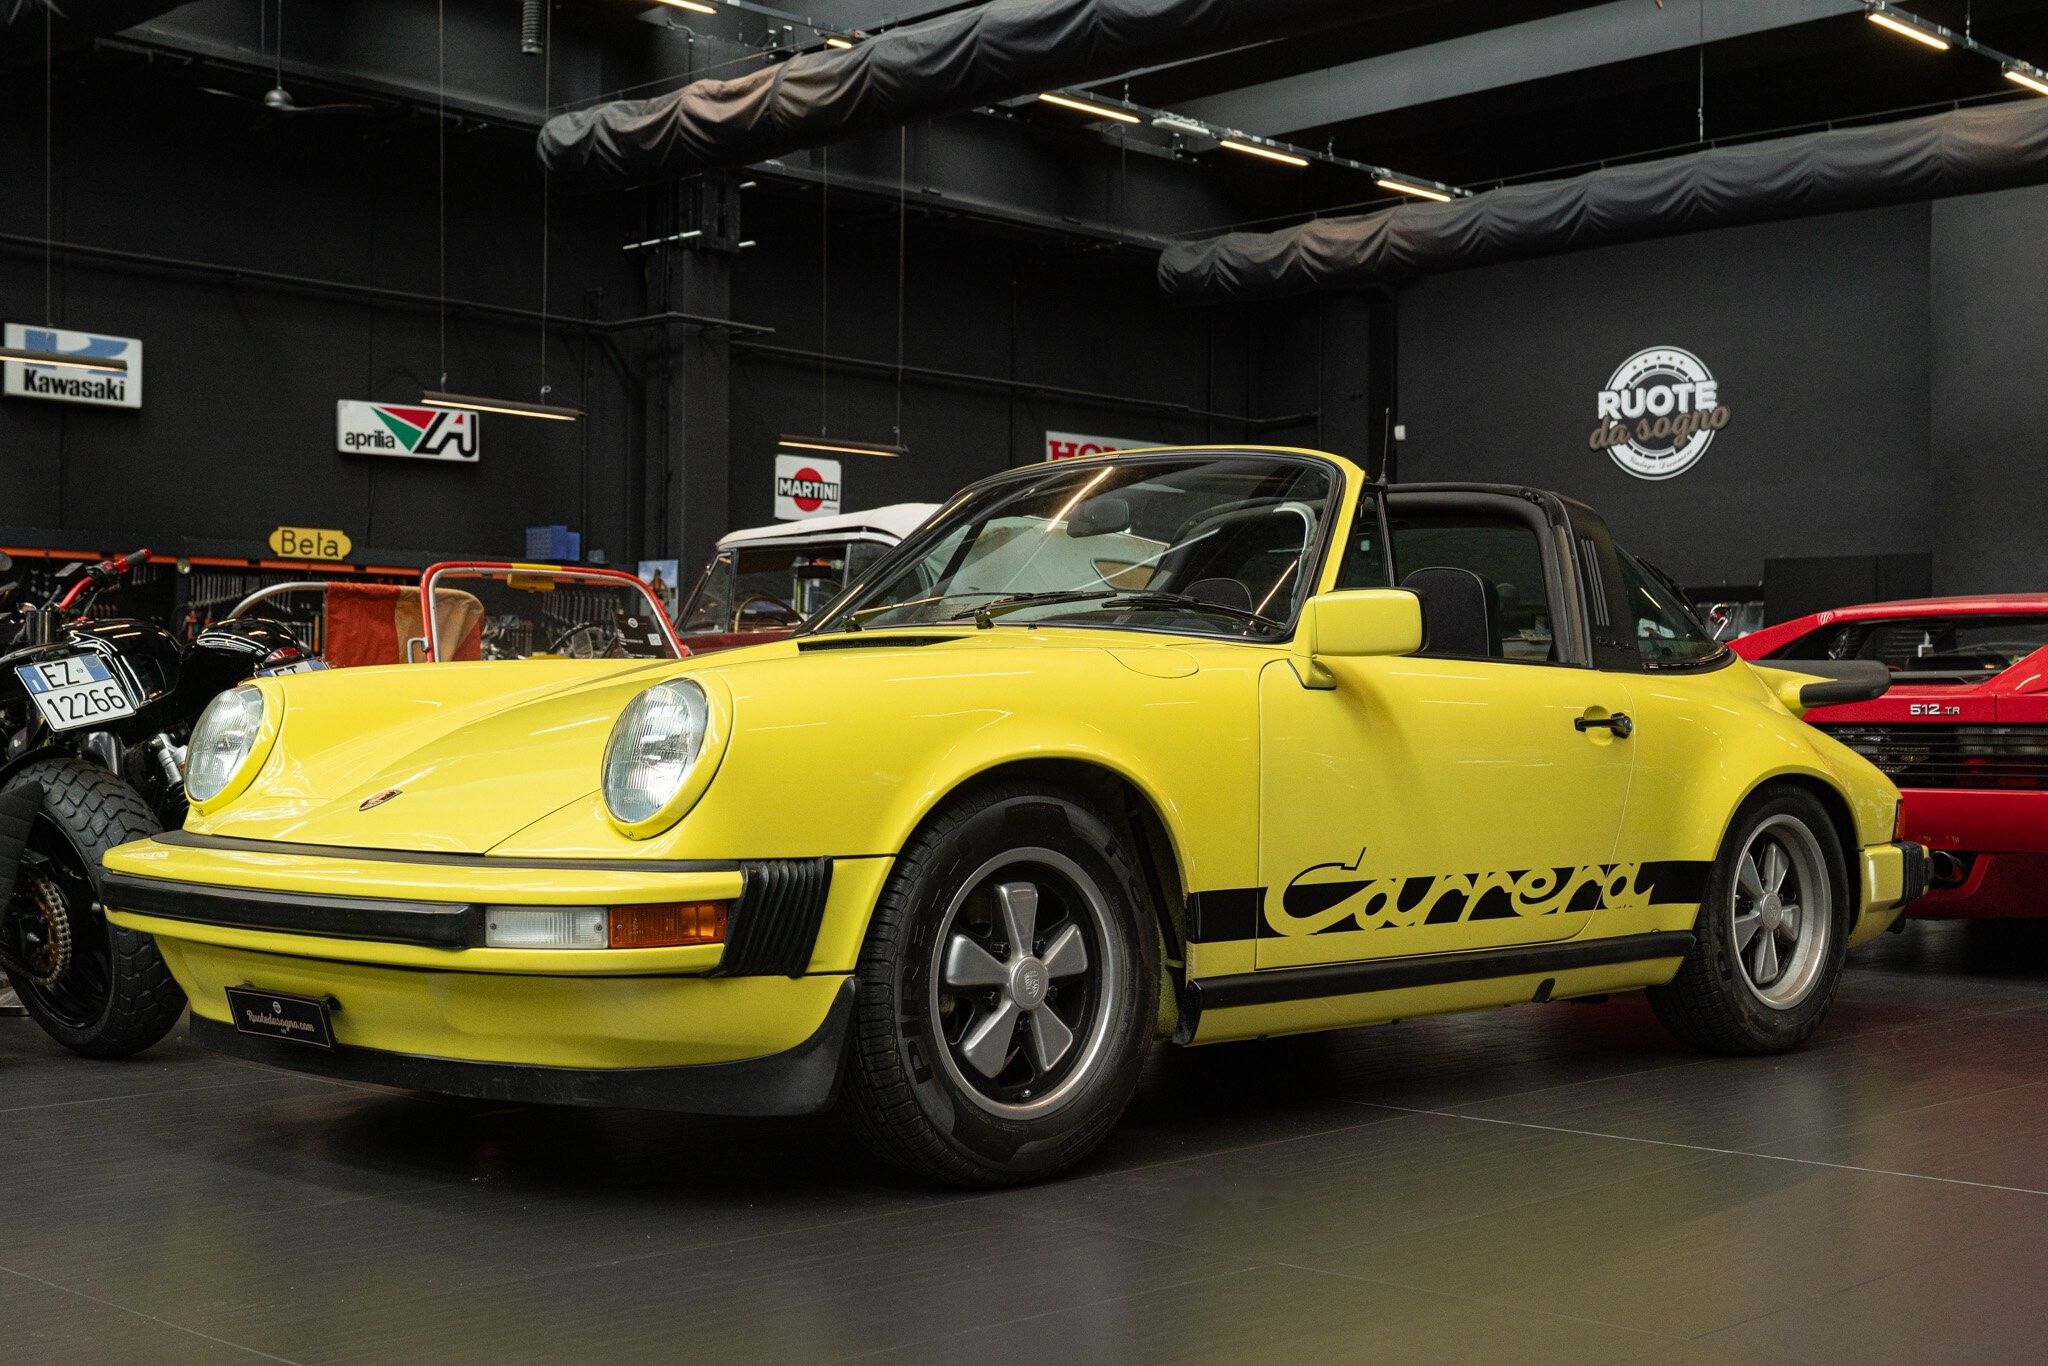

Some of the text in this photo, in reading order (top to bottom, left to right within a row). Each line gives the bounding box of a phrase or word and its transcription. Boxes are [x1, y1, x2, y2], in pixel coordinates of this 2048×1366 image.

[23, 368, 125, 402] Kawasaki
[1598, 380, 1718, 420] RUOTE
[345, 430, 396, 450] aprilia
[1589, 405, 1732, 450] da sogno
[778, 478, 838, 501] MARTINI
[281, 529, 339, 558] Beta
[39, 661, 80, 689] EZ
[46, 686, 126, 722] 12266
[1910, 703, 1960, 716] 512 TR
[1263, 846, 1656, 936] Carrera
